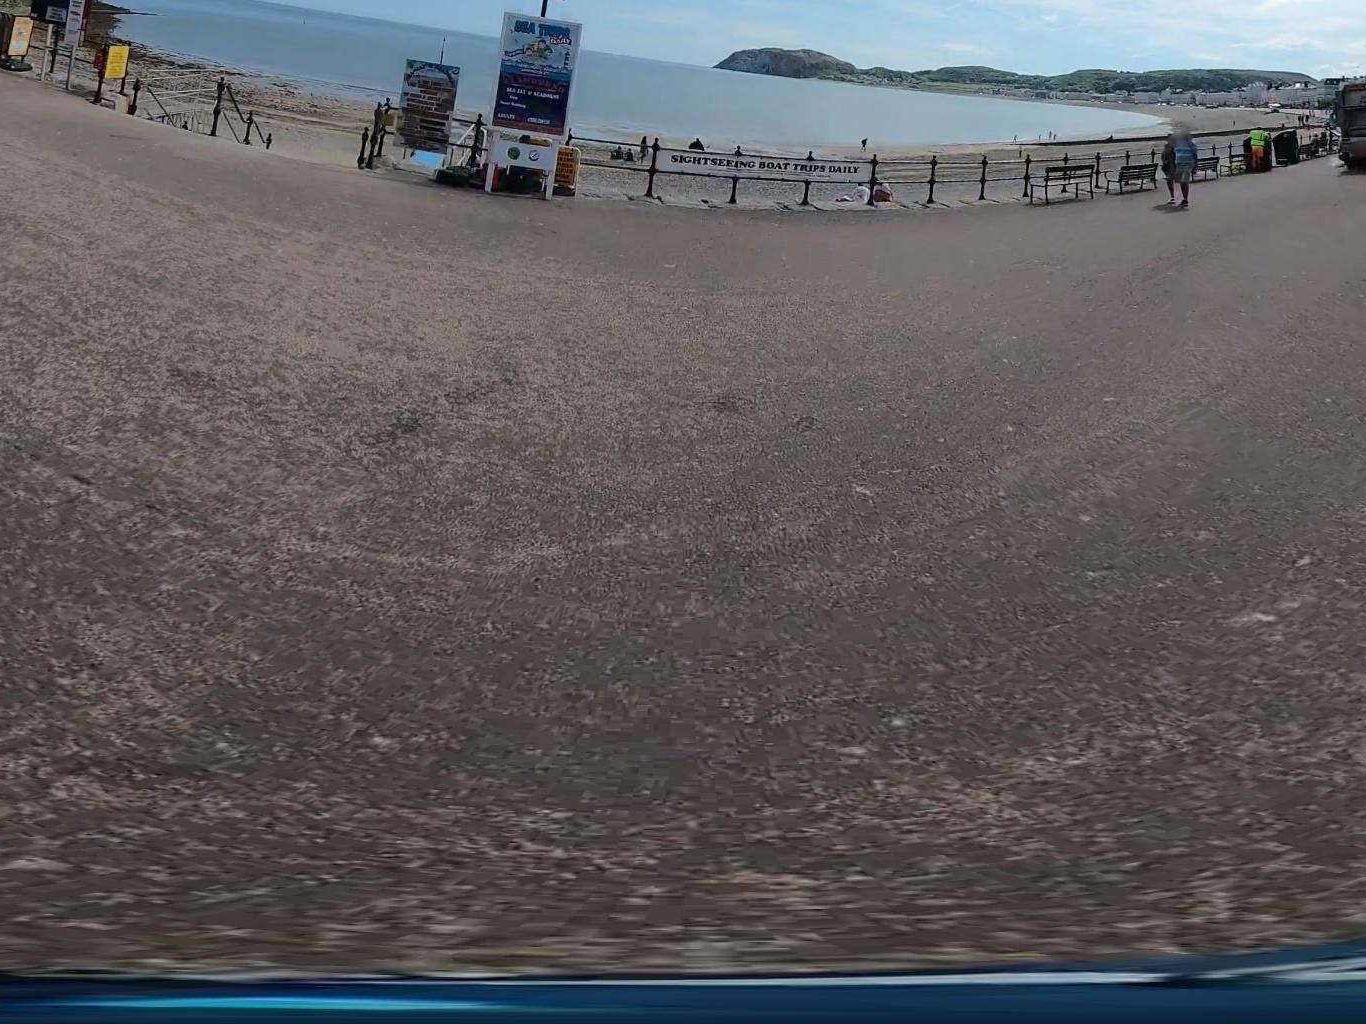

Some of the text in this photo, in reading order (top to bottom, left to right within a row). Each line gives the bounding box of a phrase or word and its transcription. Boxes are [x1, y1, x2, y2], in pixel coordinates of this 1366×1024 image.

[515, 20, 571, 39] SEA TRIPS
[550, 37, 572, 46] DAILY
[670, 154, 860, 174] SIGHTSEEING BOAT TRIPS DAILY
